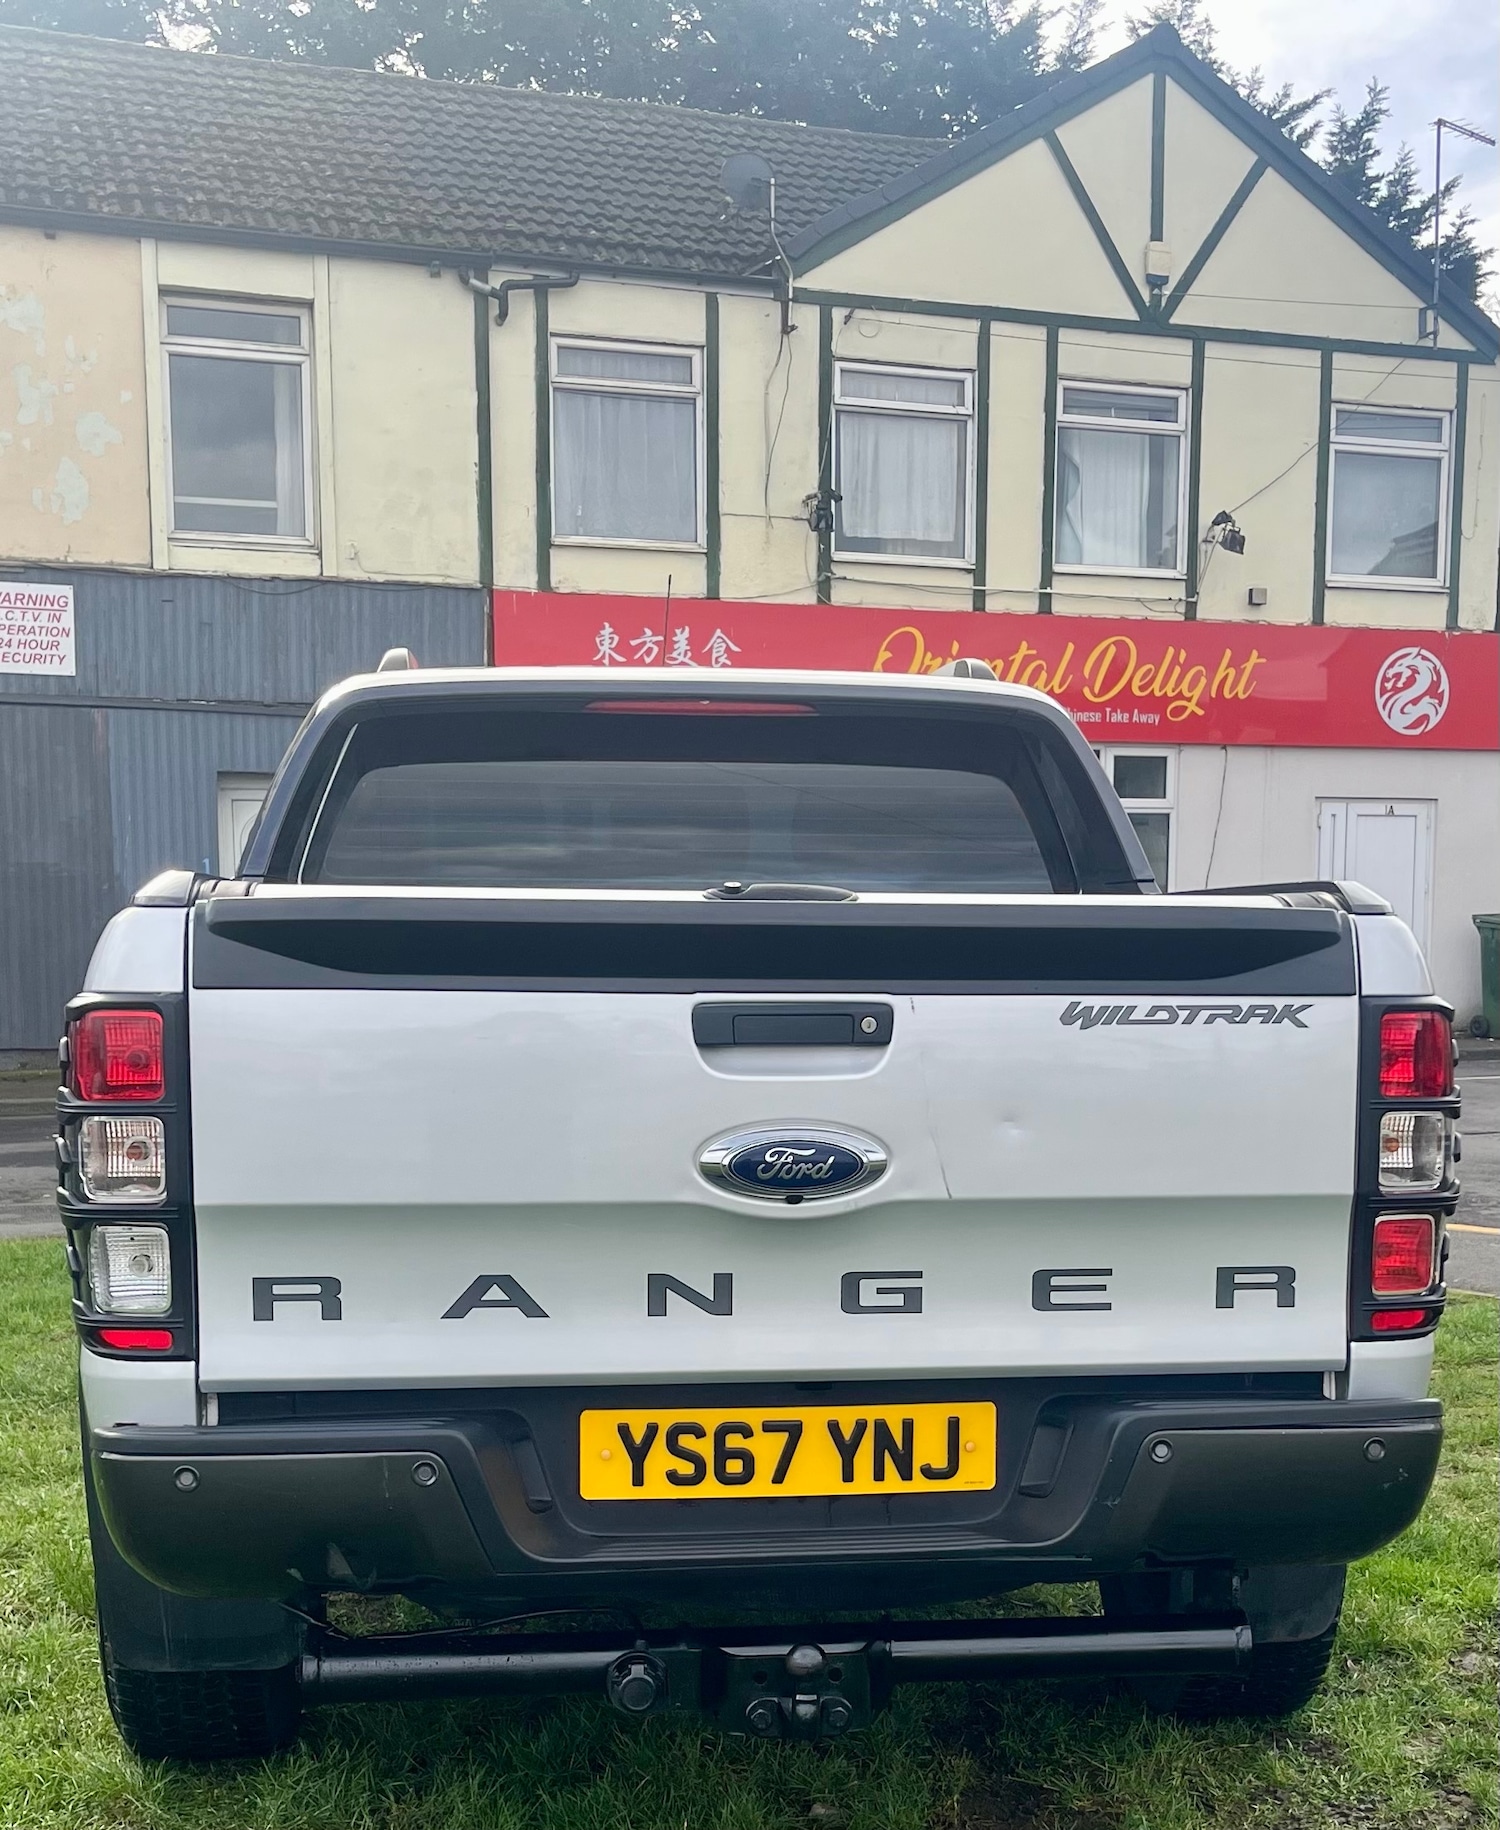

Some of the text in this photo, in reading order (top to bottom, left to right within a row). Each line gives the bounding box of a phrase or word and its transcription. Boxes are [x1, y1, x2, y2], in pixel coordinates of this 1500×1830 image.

[0, 592, 69, 608] ARNING
[47, 612, 62, 623] IN
[0, 624, 71, 638] PERATION
[17, 638, 60, 651] HOUR
[593, 622, 742, 668] 東方美食
[0, 652, 66, 665] ECURITY
[1083, 635, 1267, 721] Delight
[1105, 707, 1129, 723] Take
[1132, 708, 1160, 726] Away
[1059, 1001, 1315, 1030] WILDTRAK
[756, 1147, 835, 1180] Ford
[252, 1266, 1296, 1321] RANGER
[617, 1416, 960, 1487] YS67 YNJ
